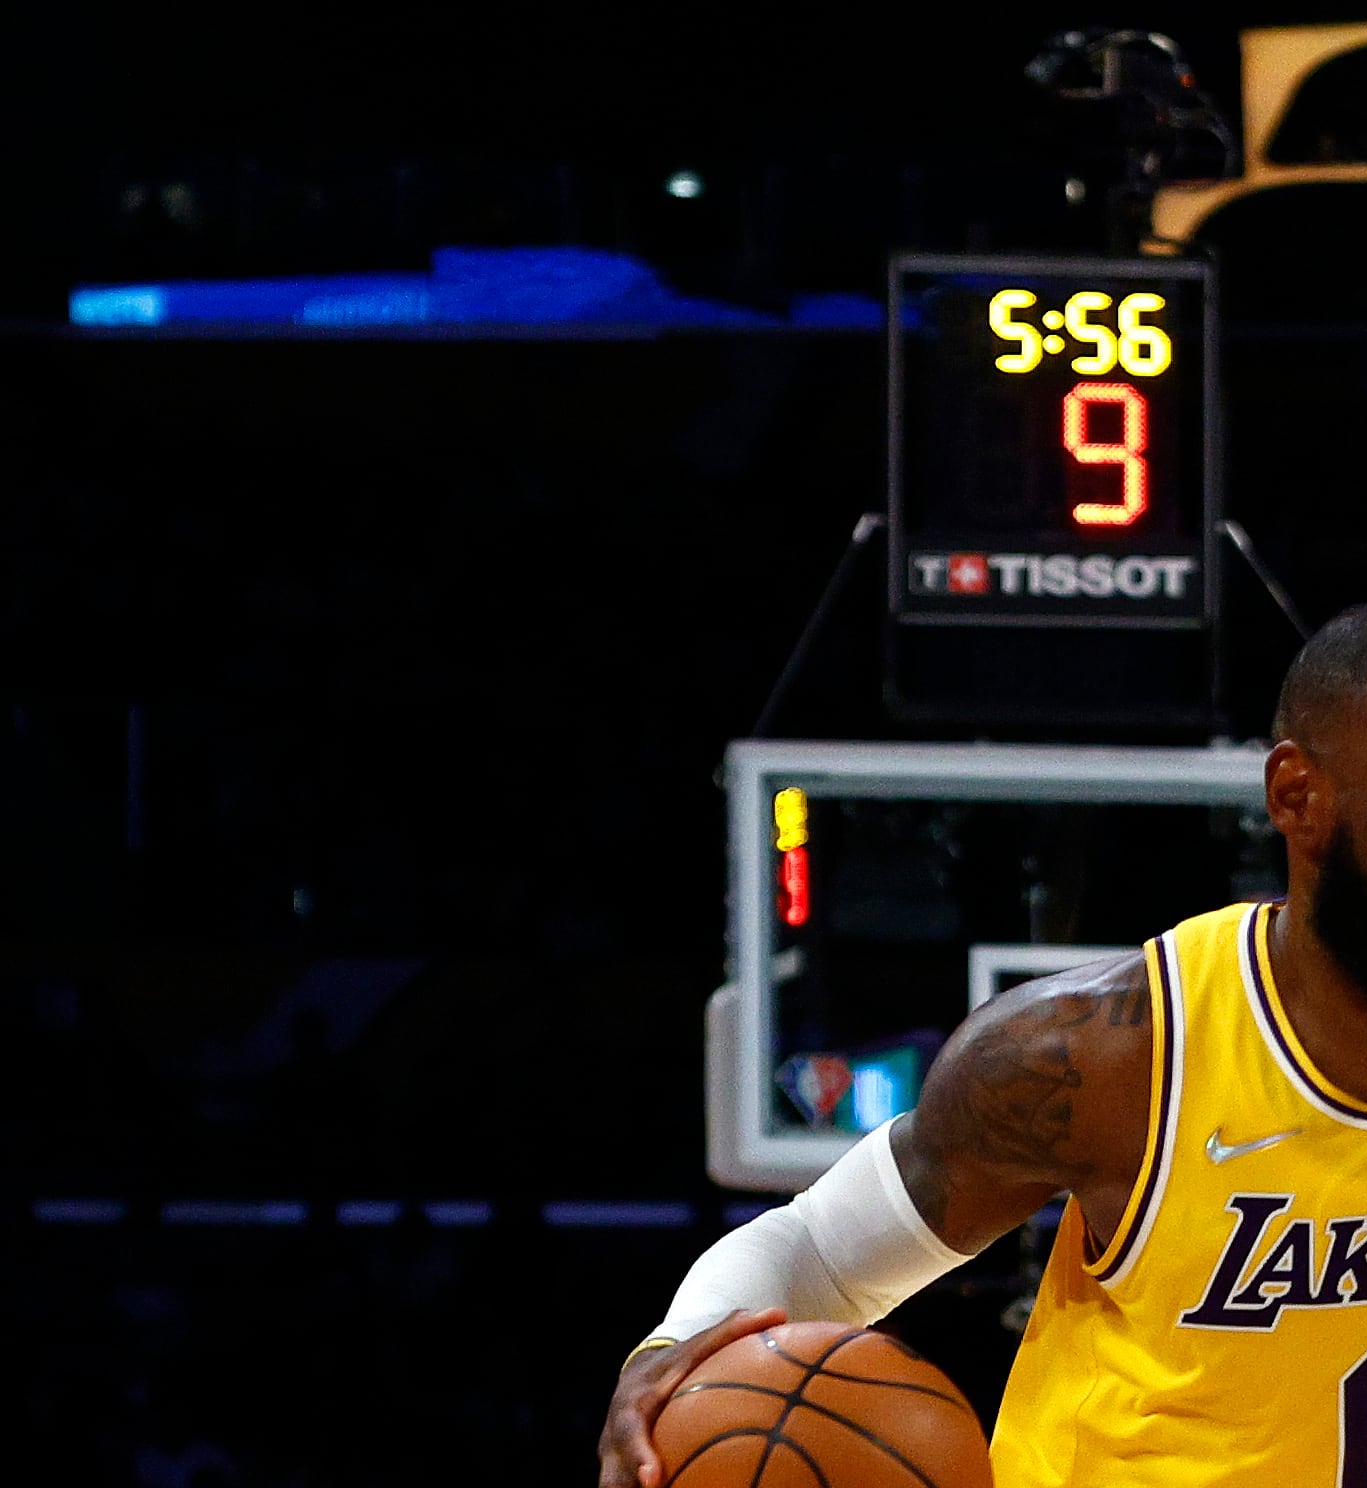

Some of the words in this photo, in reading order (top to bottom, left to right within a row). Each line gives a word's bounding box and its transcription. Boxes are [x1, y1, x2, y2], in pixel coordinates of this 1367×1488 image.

[988, 288, 1172, 377] 5:56
[1062, 382, 1148, 526] 9
[986, 554, 1197, 598] TISSOT
